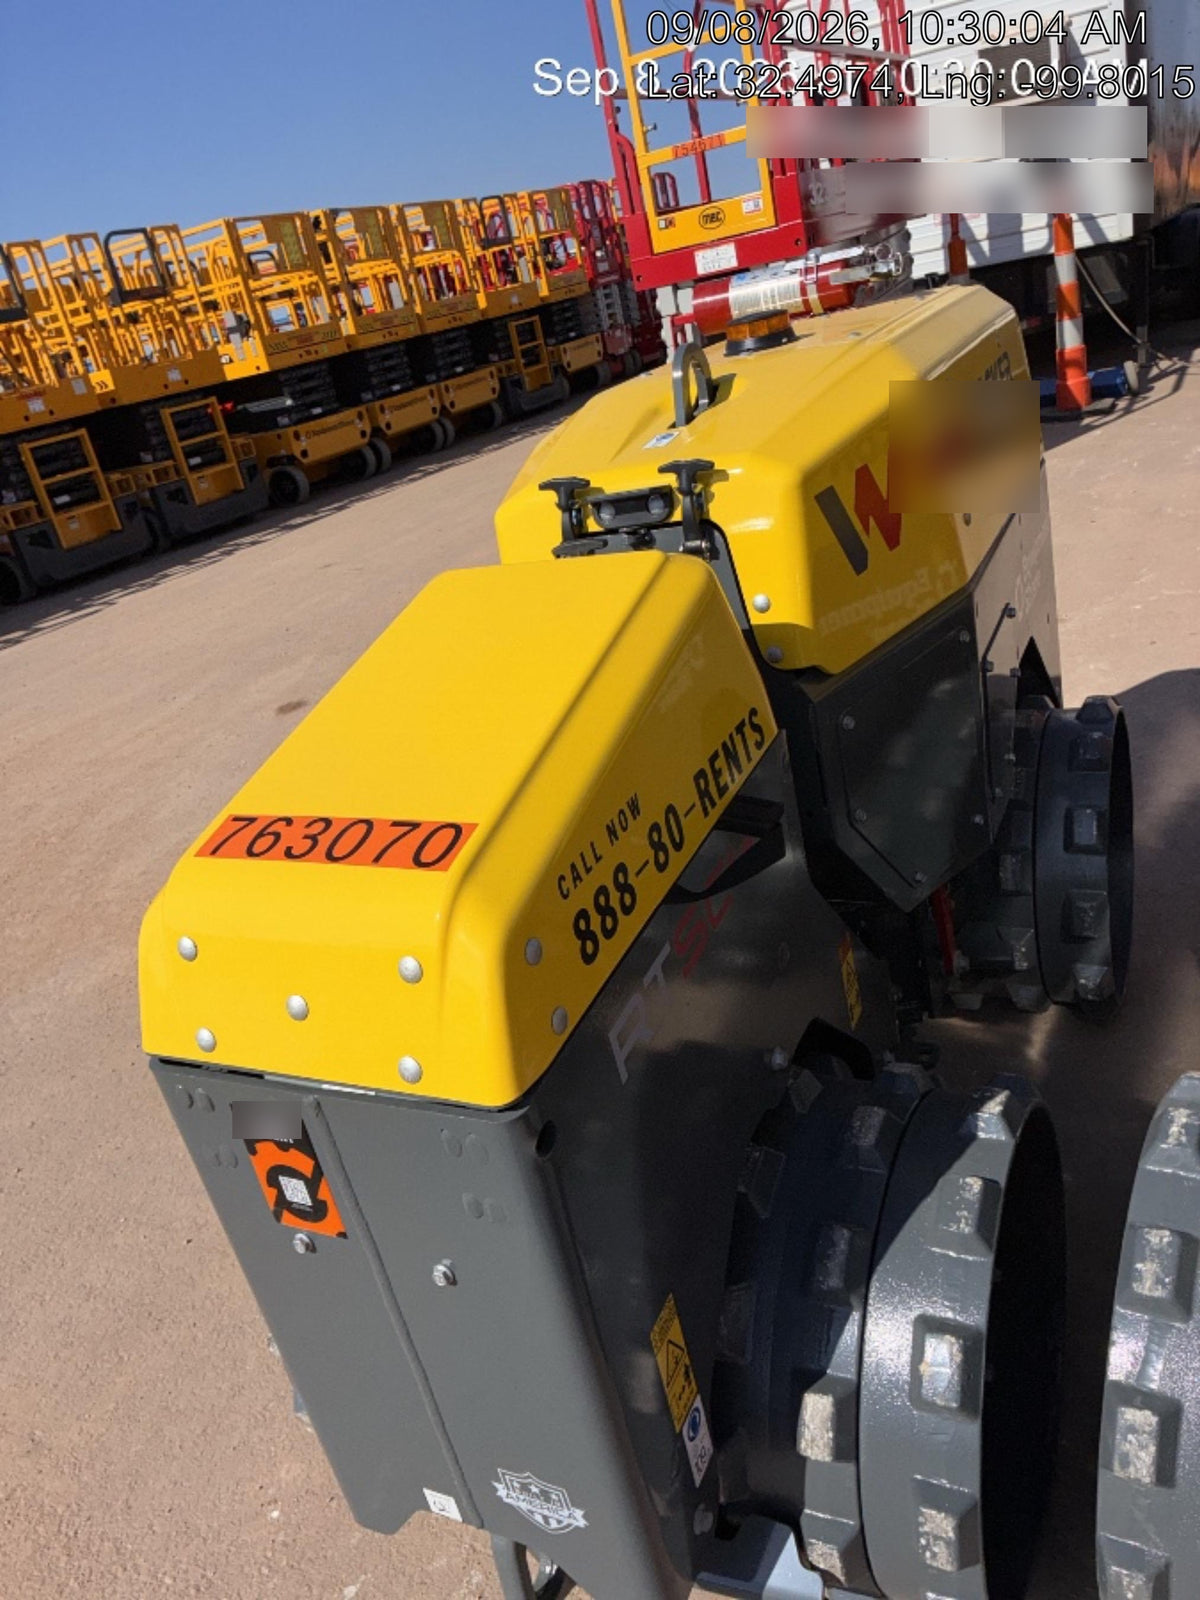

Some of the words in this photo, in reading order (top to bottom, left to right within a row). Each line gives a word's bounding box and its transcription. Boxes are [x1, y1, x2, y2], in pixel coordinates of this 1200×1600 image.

[209, 816, 463, 869] 763070
[557, 841, 603, 900] CALL
[605, 793, 641, 847] NOW
[573, 706, 766, 966] 888-80-RENTS
